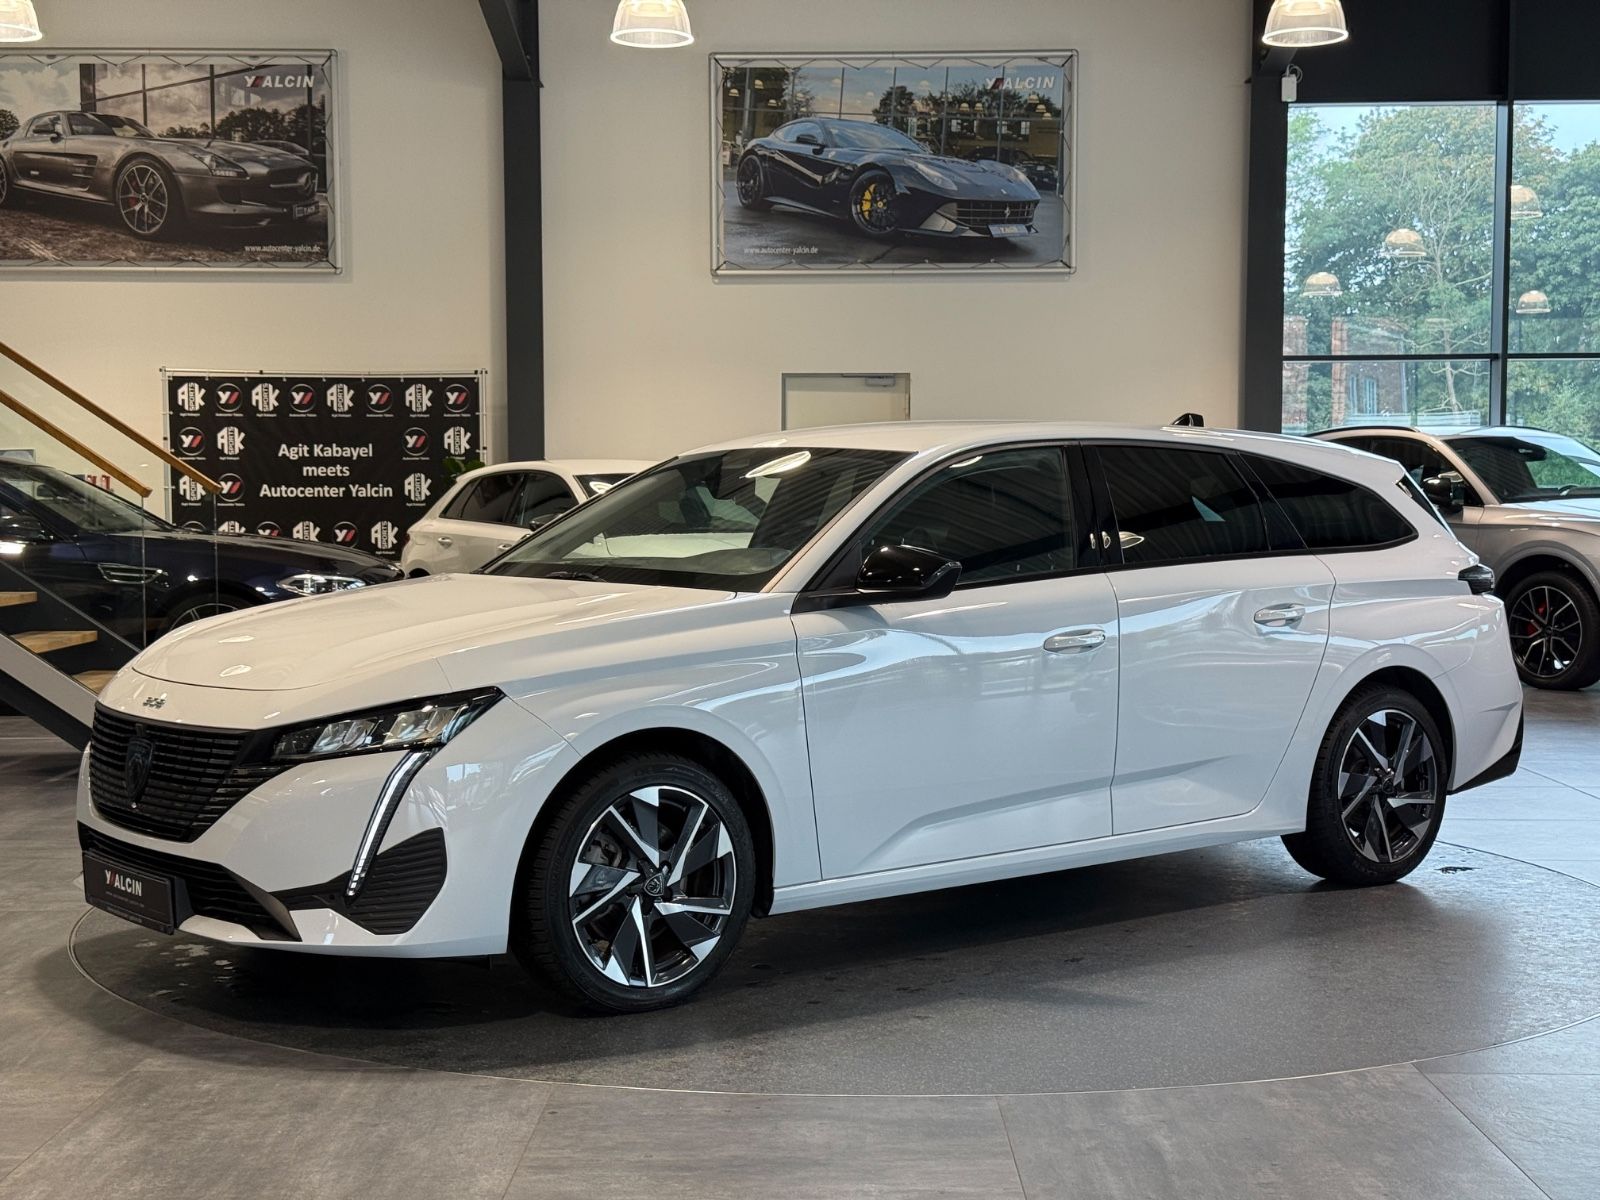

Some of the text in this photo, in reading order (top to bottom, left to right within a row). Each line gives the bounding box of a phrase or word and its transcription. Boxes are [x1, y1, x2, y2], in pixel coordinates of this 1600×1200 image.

[244, 244, 321, 253] www.autocenter-yalcin.de
[743, 245, 819, 255] www.autocenter-yalcin.de
[278, 443, 373, 460] Agit Kabayel
[302, 464, 350, 477] meets
[259, 483, 393, 498] Autocenter Yalcin
